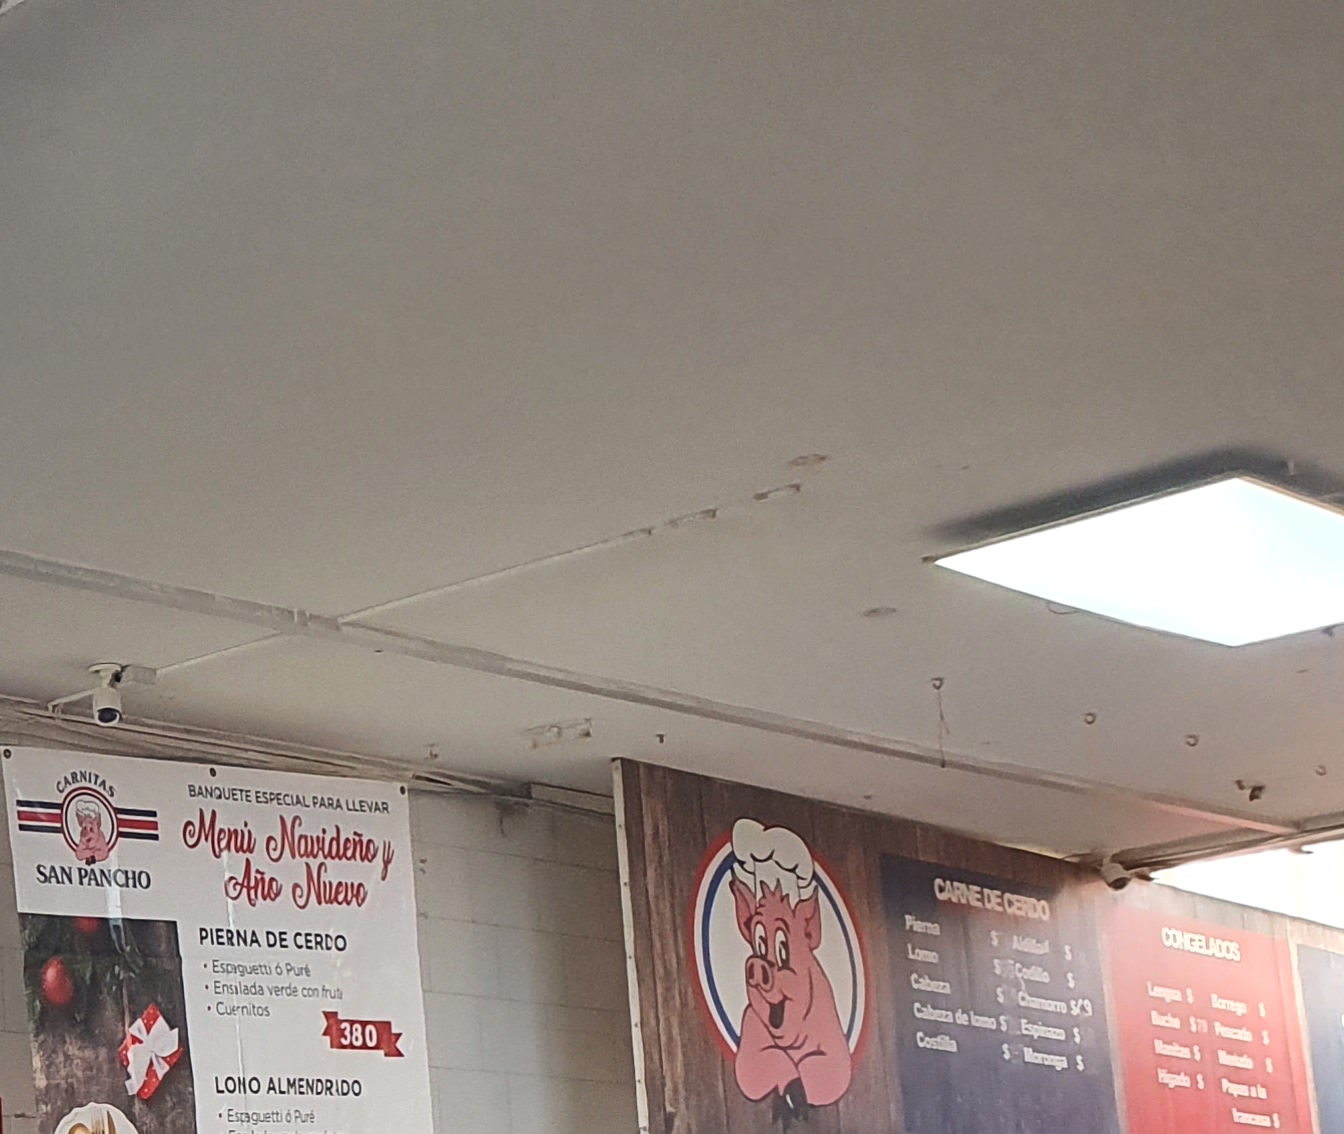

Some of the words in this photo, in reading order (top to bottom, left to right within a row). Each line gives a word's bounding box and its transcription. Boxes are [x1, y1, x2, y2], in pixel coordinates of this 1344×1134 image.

[56, 770, 115, 798] CARNITAS
[188, 784, 252, 803] BANQUETE
[255, 790, 311, 808] ESPECIAL
[312, 795, 343, 811] PARA
[346, 799, 390, 814] LLEVAR
[265, 814, 379, 863] Navideño
[380, 839, 395, 882] y
[36, 863, 73, 885] SAN
[77, 867, 151, 890] PANCHO
[224, 857, 283, 907] Año
[292, 861, 368, 910] Nuevo
[933, 877, 983, 908] CARNE
[983, 889, 1004, 913] DE
[1003, 891, 1050, 921] CERDO
[198, 927, 261, 948] PIERNA
[265, 930, 289, 949] DE
[293, 931, 347, 952] CERDO
[1161, 926, 1241, 962] CONGELADOS
[212, 959, 272, 978] Espaguetti
[285, 962, 311, 977] Puré
[213, 981, 264, 996] Ensalada
[267, 983, 298, 998] verde
[301, 985, 319, 999] con
[215, 1001, 270, 1017] Cuernitos
[339, 1021, 378, 1048] 380
